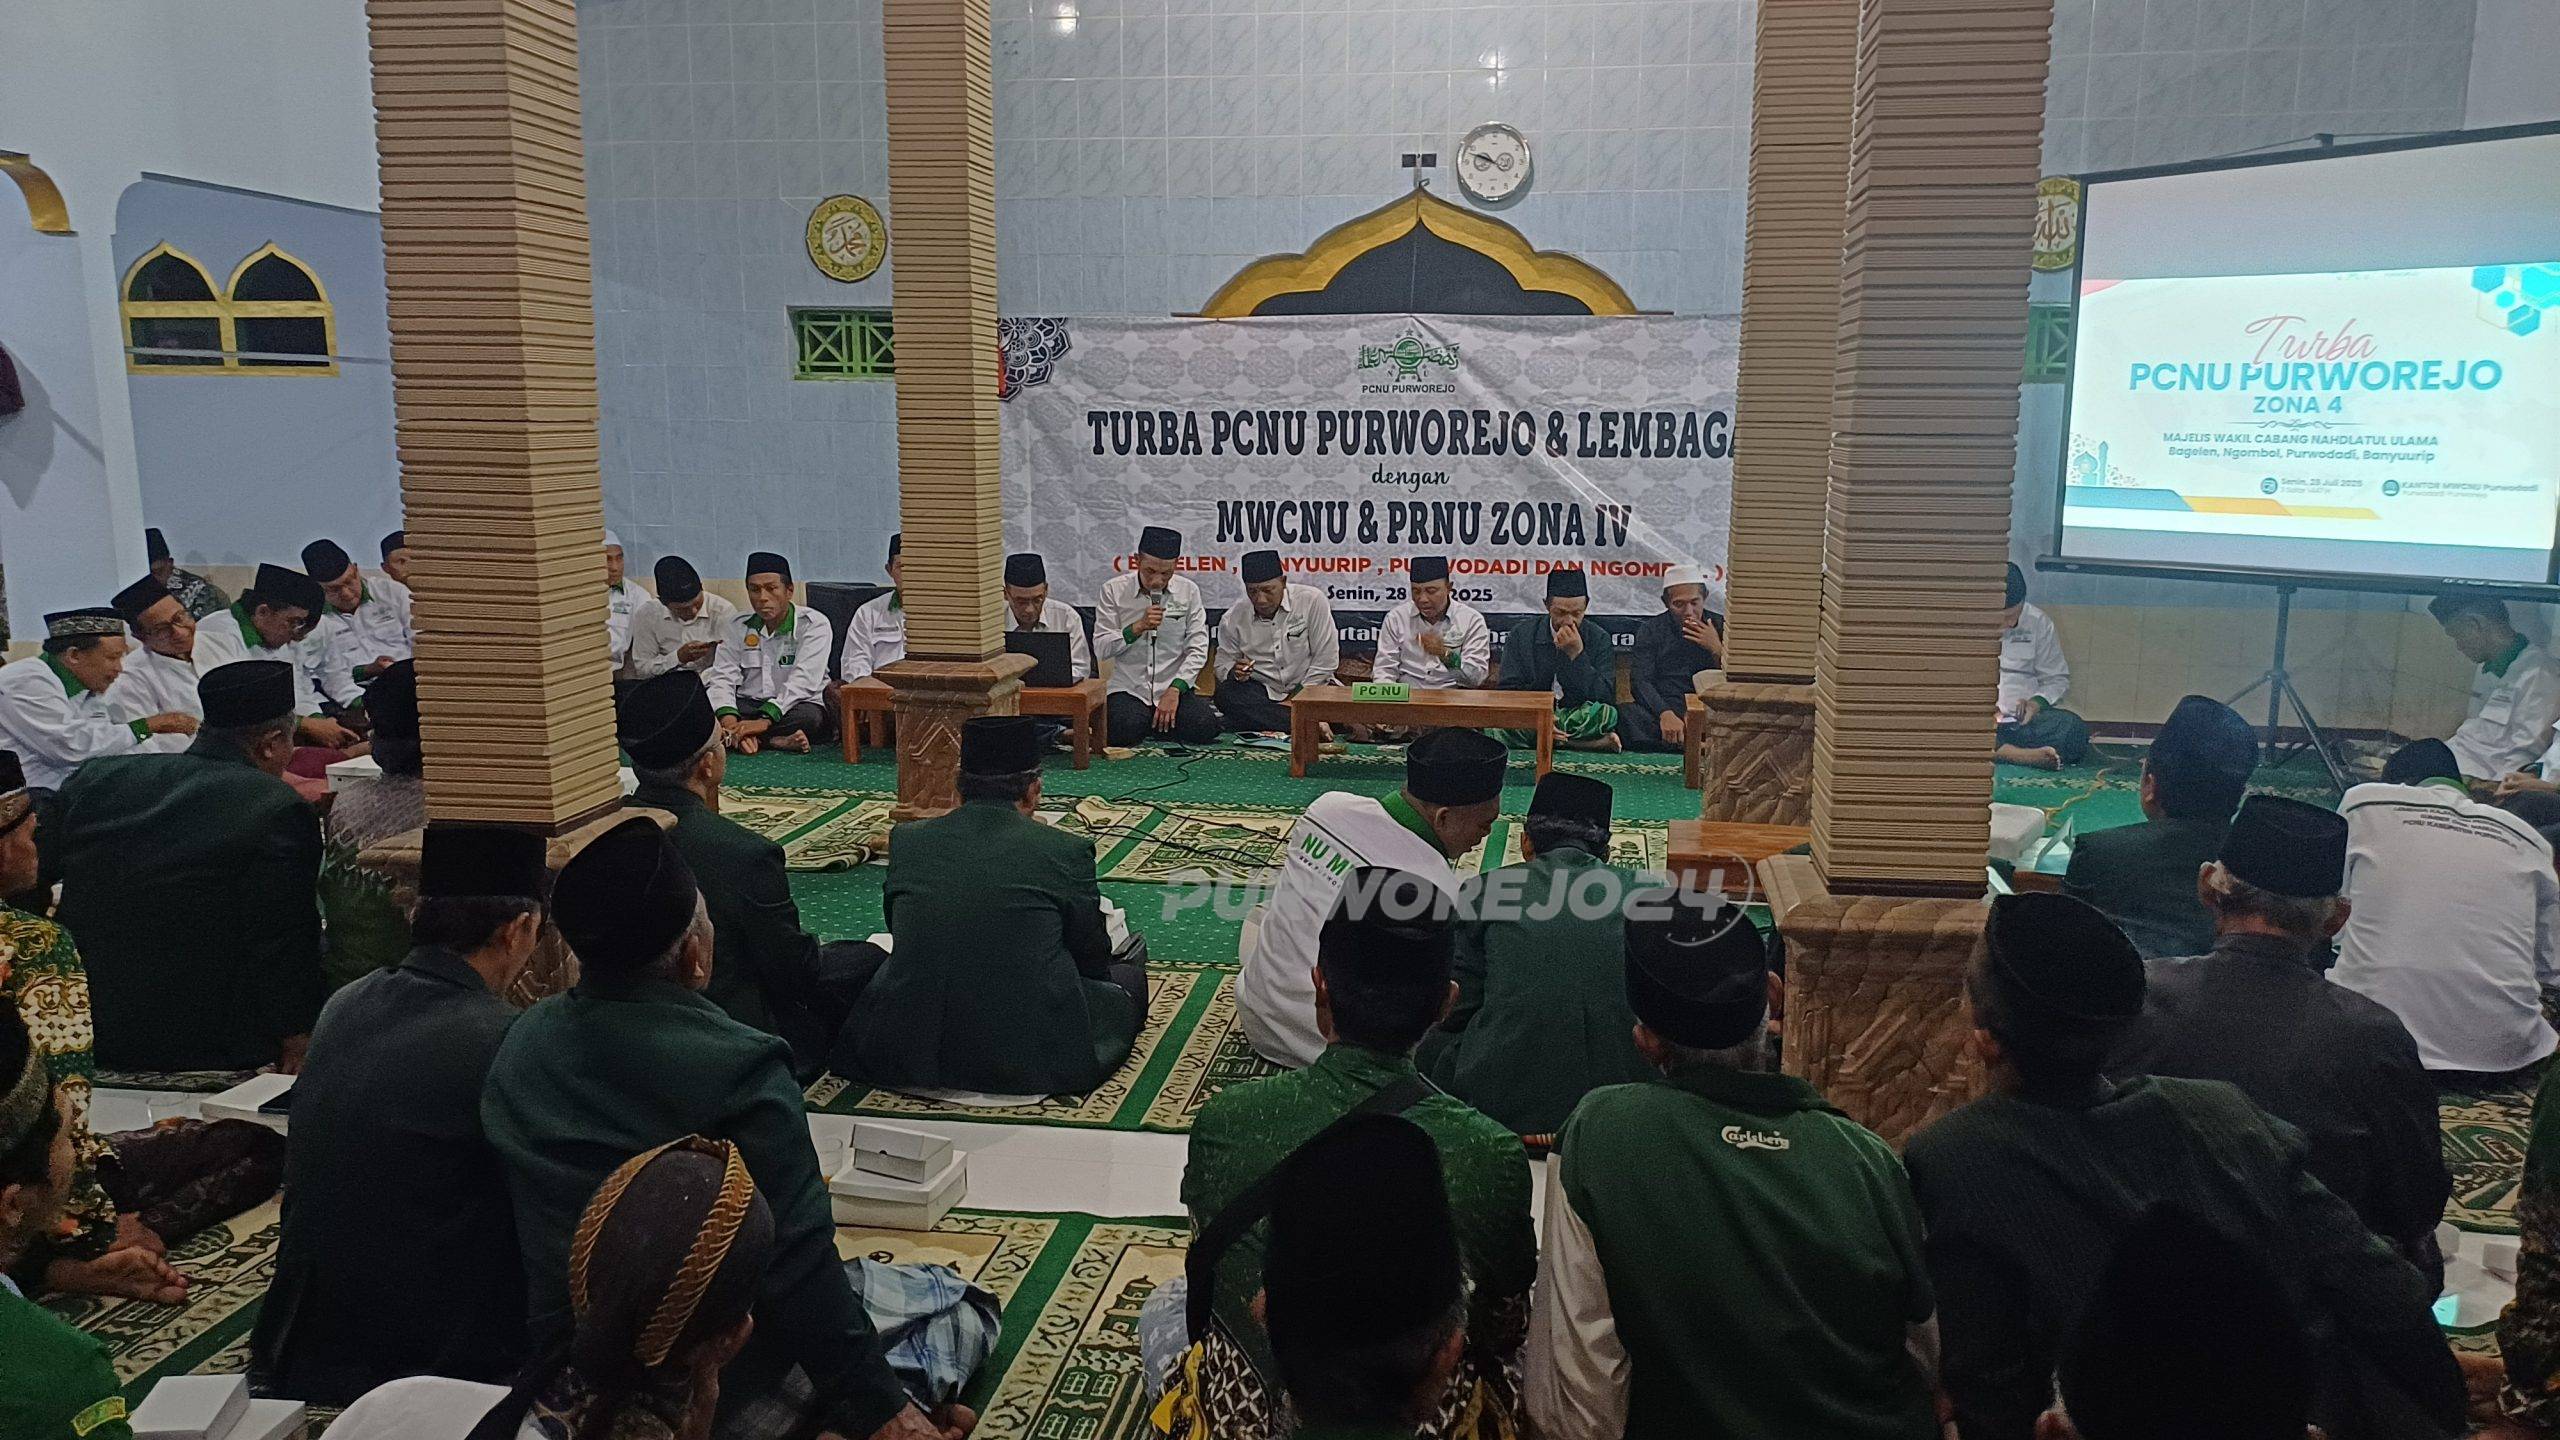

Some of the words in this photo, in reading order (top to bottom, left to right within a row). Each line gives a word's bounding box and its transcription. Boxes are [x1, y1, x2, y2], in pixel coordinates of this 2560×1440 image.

[2245, 314, 2379, 365] Turba
[2129, 362, 2232, 391] PCNU
[2239, 360, 2503, 391] PURWOREJO
[1361, 384, 1390, 393] PCNU
[1391, 384, 1456, 393] PURWOREJO
[2253, 396, 2321, 414] ZONA
[2327, 396, 2342, 413] 4
[1087, 410, 1203, 456] TURBA
[1211, 410, 1307, 456] PCNU
[1316, 409, 1537, 457] PURWOREJO
[1545, 411, 1568, 458] &
[2163, 433, 2211, 443] MAJELIS
[2214, 434, 2252, 443] WAKIL
[2254, 434, 2309, 444] CABANG
[2311, 435, 2388, 446] NAHDLATUL
[2390, 436, 2438, 446] ULAMA
[2168, 446, 2220, 459] Bagelen,
[2363, 450, 2435, 463] Banyuurip
[1371, 462, 1450, 493] dengan
[1216, 500, 1349, 544] MWCNU
[1357, 500, 1378, 544] &
[1387, 501, 1482, 545] PRNU
[1490, 502, 1586, 546] ZONA
[1595, 504, 1632, 547] IV
[1128, 556, 1226, 572] BELEN
[1279, 557, 1372, 573] NYUURIP
[1535, 559, 1583, 576] DAN
[1327, 585, 1381, 602] Senin,
[1386, 587, 1407, 600] 28
[1450, 588, 1493, 602] 2025
[1359, 685, 1377, 696] PC
[1381, 686, 1401, 696] NU
[1300, 832, 1330, 860] NU
[1721, 1125, 1790, 1151] Carlsberg
